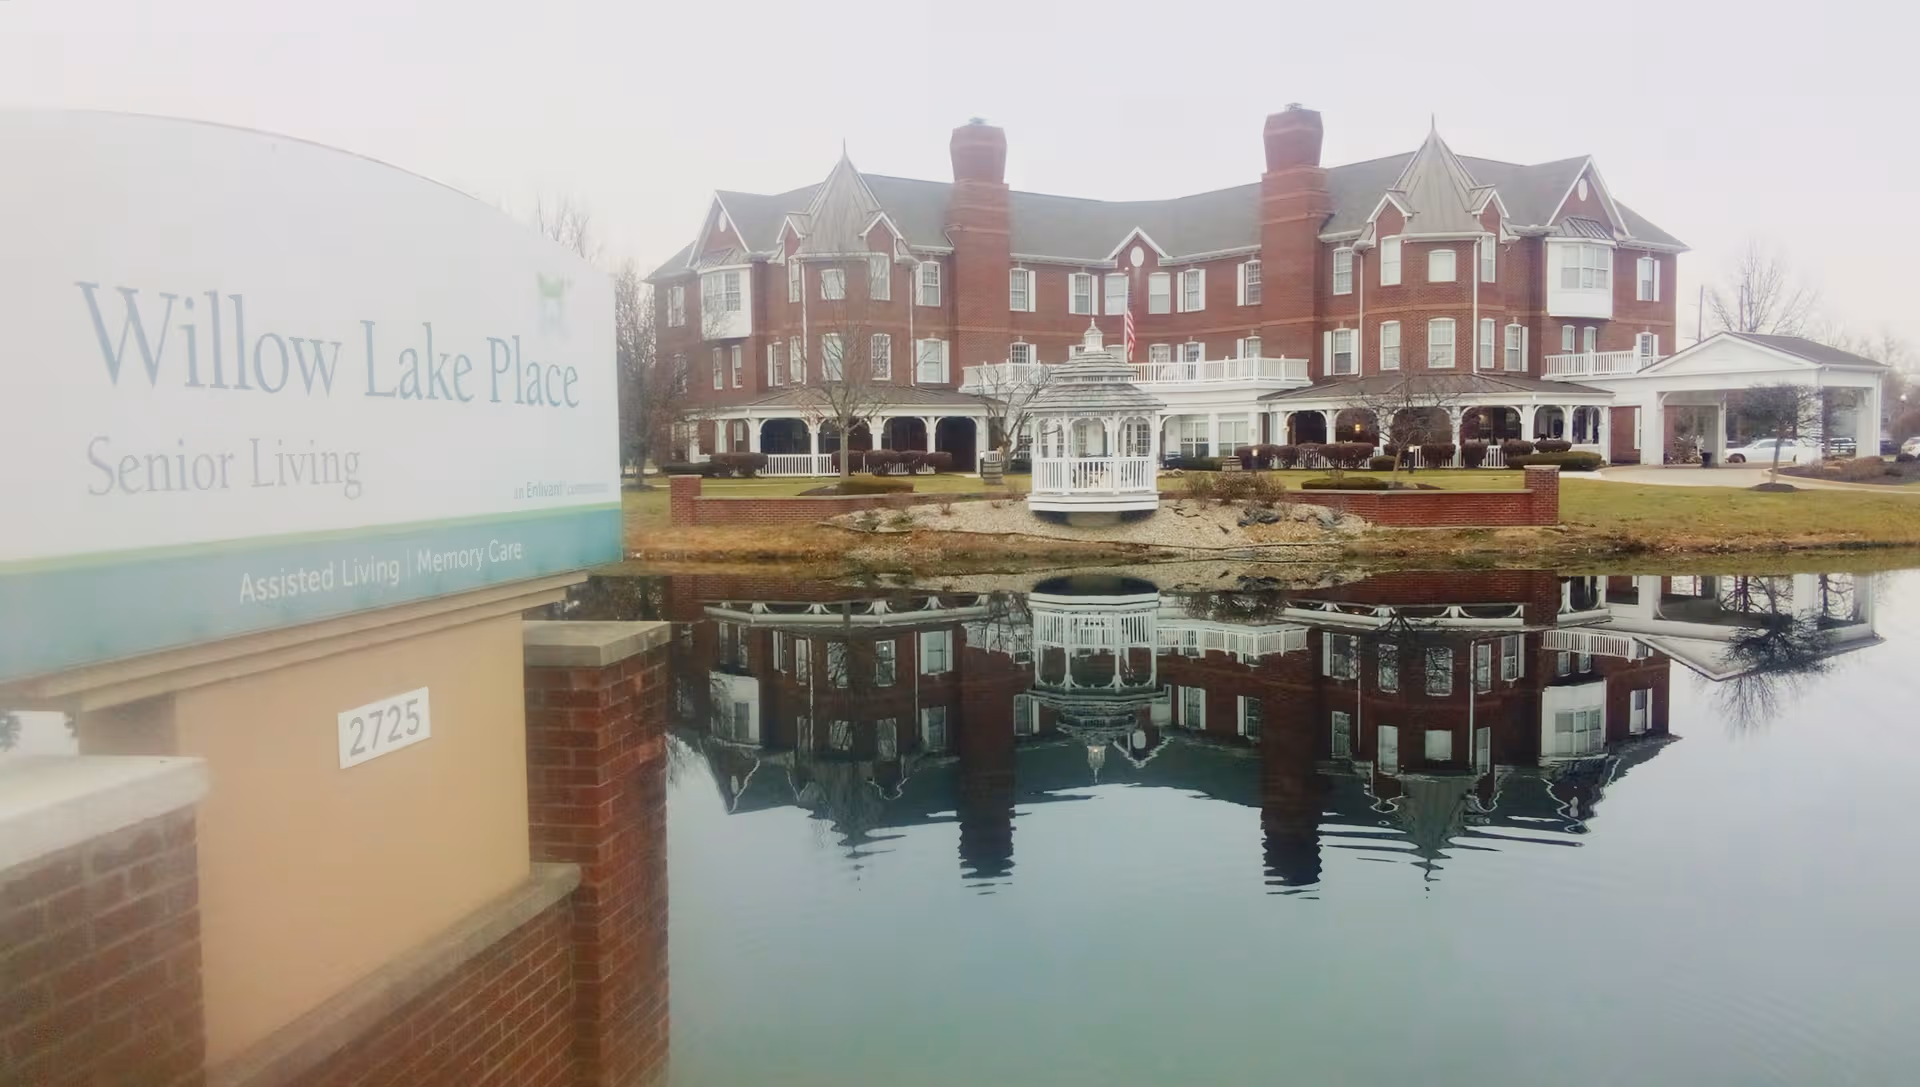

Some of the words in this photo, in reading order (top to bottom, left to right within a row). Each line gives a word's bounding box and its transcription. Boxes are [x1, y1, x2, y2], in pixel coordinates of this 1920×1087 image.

[75, 280, 342, 397] Willow
[359, 319, 475, 402] Lake
[486, 334, 580, 408] Place
[86, 435, 235, 497] Senior
[248, 437, 363, 501] Living
[239, 562, 334, 603] Assisted
[342, 555, 400, 586] Living
[417, 546, 484, 571] Memory
[488, 539, 523, 562] Care
[349, 698, 420, 758] 2725
